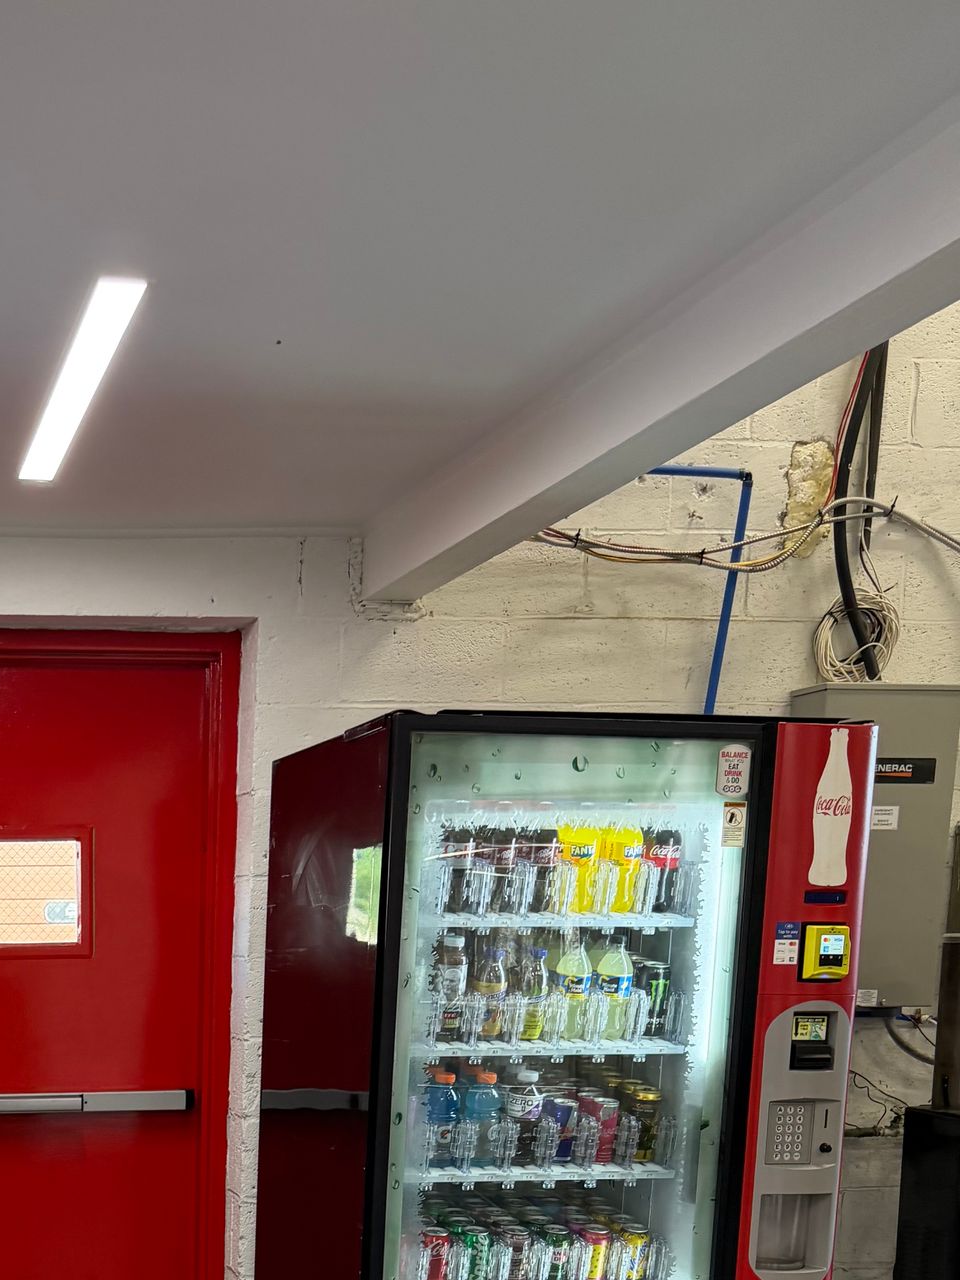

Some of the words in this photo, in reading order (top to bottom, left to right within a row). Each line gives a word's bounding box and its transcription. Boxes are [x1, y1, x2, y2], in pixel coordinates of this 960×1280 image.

[721, 751, 749, 759] BALANCE
[874, 764, 913, 772] ENERAC
[816, 795, 852, 816] Coca-Cola
[509, 1098, 534, 1107] ZERO
